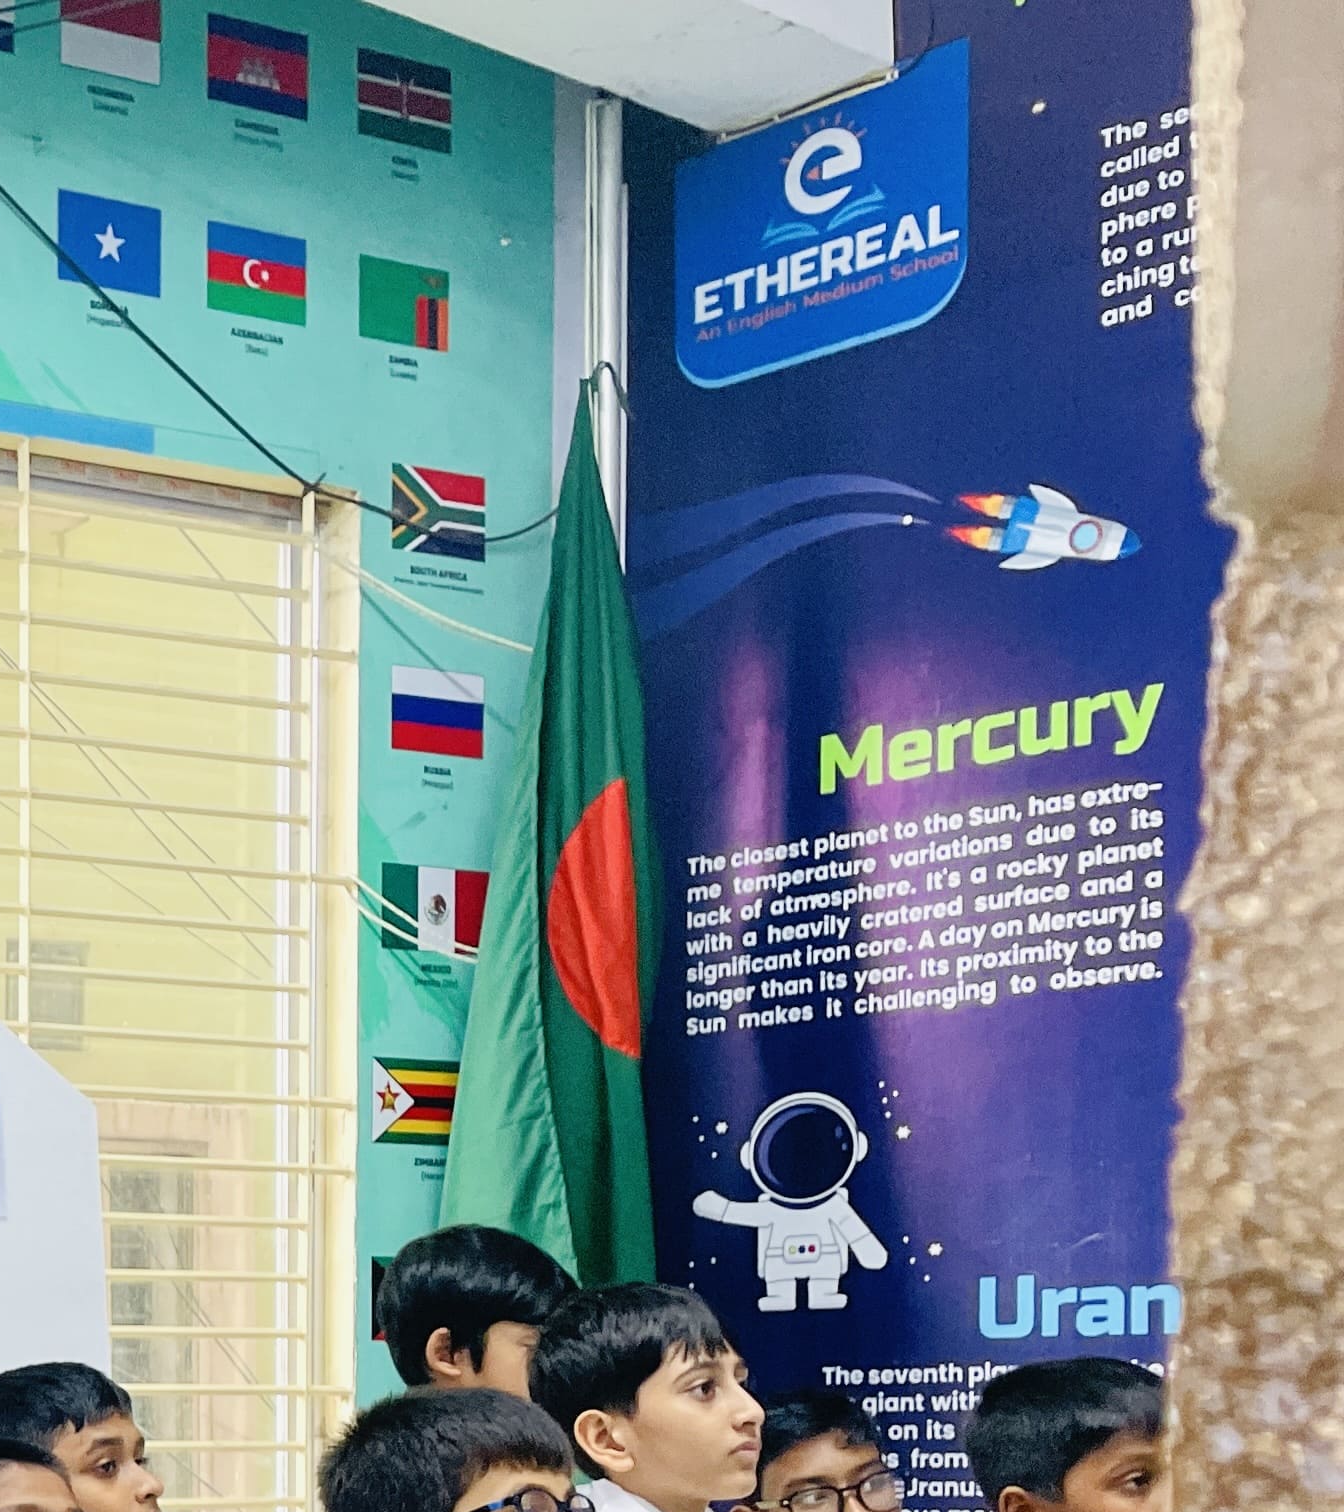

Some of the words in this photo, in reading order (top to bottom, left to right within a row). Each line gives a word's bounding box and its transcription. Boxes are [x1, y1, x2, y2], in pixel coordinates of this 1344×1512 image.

[1100, 120, 1148, 148] The
[1100, 135, 1181, 178] called
[1100, 179, 1151, 208] due
[1157, 169, 1185, 191] to
[1100, 201, 1177, 245] phere
[1100, 245, 1128, 267] to
[1135, 237, 1154, 257] a
[693, 204, 960, 325] ETHEREAL
[695, 325, 722, 344] An
[727, 299, 798, 334] English
[802, 273, 884, 309] Medium
[889, 245, 960, 281] School
[1100, 261, 1176, 297] ching
[1100, 293, 1154, 327] and
[819, 682, 1165, 795] Mercury
[687, 855, 726, 876] The
[730, 838, 809, 868] closest
[814, 823, 889, 860] planet
[893, 821, 919, 841] to
[922, 812, 964, 836] the
[968, 803, 1023, 827] Sun,
[1028, 793, 1076, 817] has
[1080, 782, 1163, 809] extre-
[687, 883, 722, 903] me
[732, 857, 877, 895] temperature
[888, 833, 1013, 870] variations
[1025, 823, 1076, 846] due
[1088, 816, 1117, 837] to
[1130, 807, 1164, 831] its
[686, 932, 733, 955] with
[742, 931, 757, 947] a
[767, 914, 851, 944] heavily
[860, 894, 963, 930] cratered
[974, 883, 1070, 913] surface
[1080, 869, 1133, 897] and
[1144, 870, 1163, 889] a
[687, 905, 732, 929] lack
[740, 898, 763, 921] of
[770, 879, 917, 916] atmosphere.
[925, 866, 962, 893] It's
[969, 866, 987, 885] a
[996, 852, 1069, 881] rocky
[1077, 836, 1164, 875] planet
[686, 985, 756, 1010] longer
[761, 978, 813, 999] than
[820, 970, 847, 991] its
[854, 964, 914, 993] year.
[919, 957, 950, 979] Its
[955, 938, 1079, 978] proximity
[1084, 935, 1113, 957] to
[1118, 929, 1163, 952] the
[687, 949, 802, 986] significant
[806, 944, 851, 965] iron
[855, 936, 914, 958] core.
[917, 927, 936, 951] A
[938, 923, 987, 949] day
[990, 918, 1024, 939] on
[1027, 903, 1136, 935] Mercury
[1140, 896, 1163, 920] is
[686, 1016, 726, 1035] Sun
[738, 1005, 813, 1029] makes
[826, 997, 842, 1018] it
[854, 978, 997, 1014] challenging
[1009, 974, 1037, 995] to
[1049, 962, 1163, 990] observe.
[978, 1274, 1182, 1340] Uran
[821, 1365, 864, 1386] The
[868, 1362, 963, 1385] seventh
[887, 1424, 918, 1441] on
[926, 1418, 956, 1441] its
[910, 1447, 969, 1469] from
